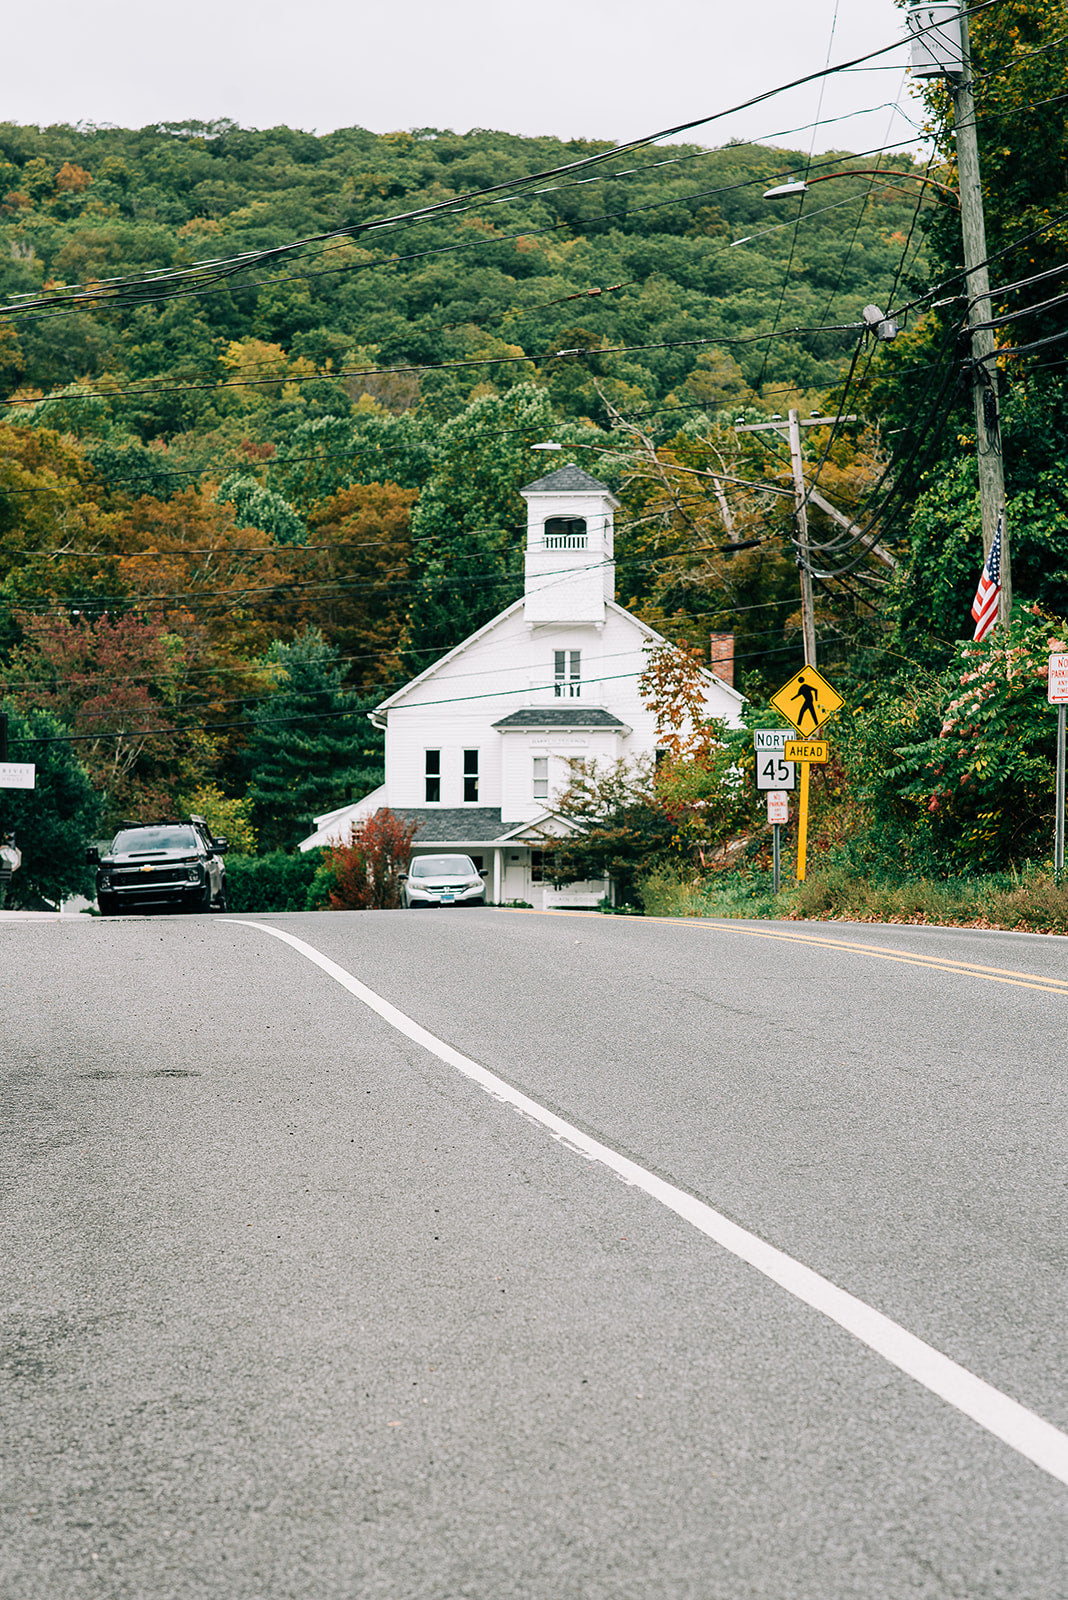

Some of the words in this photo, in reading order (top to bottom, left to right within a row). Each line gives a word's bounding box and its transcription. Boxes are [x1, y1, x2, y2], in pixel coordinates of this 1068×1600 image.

[1051, 669, 1068, 678] PARK
[790, 746, 823, 757] AHEAD
[762, 759, 789, 781] 45
